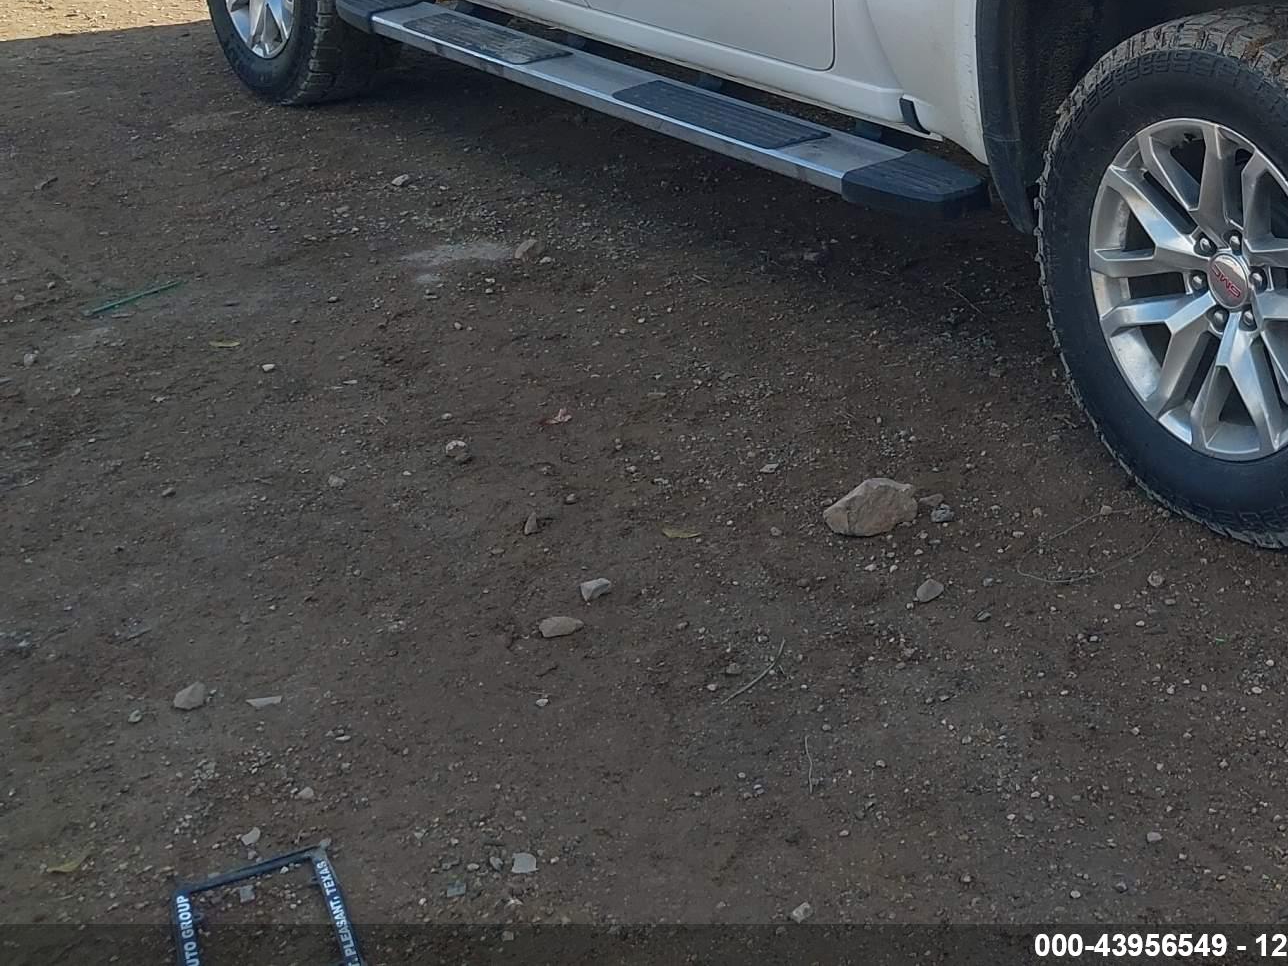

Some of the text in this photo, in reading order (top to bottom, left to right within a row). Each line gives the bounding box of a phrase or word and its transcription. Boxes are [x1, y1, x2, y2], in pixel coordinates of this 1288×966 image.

[1210, 263, 1241, 298] GMC
[316, 860, 337, 896] TEXAS
[176, 894, 200, 966] UTO GROUP
[329, 896, 357, 957] PLEASANT,
